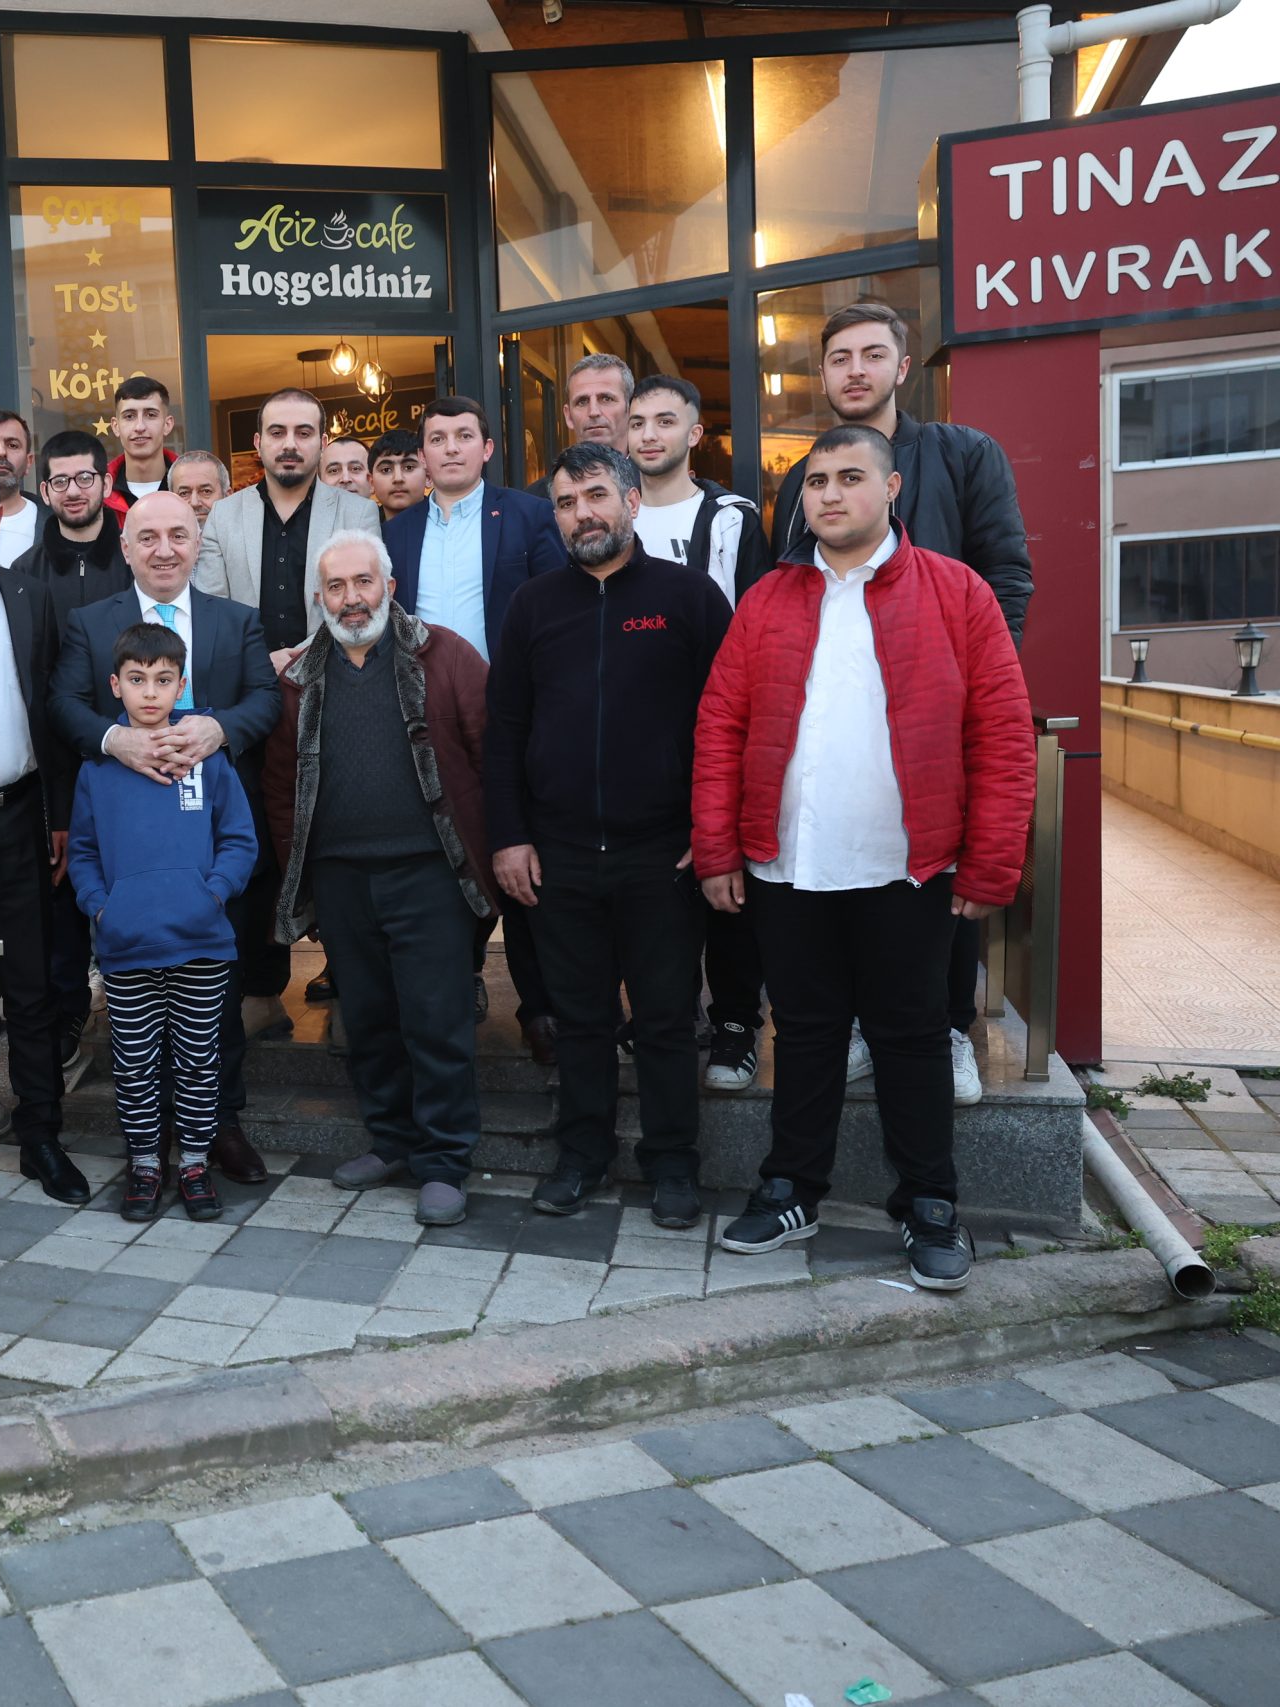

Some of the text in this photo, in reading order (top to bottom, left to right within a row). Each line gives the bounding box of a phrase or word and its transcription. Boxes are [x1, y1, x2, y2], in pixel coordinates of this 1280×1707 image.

[989, 125, 1279, 221] TINAZ
[234, 203, 416, 254] Aziz cafe
[220, 263, 432, 306] Hoşgeldiniz
[975, 228, 1272, 311] KIVRAK
[55, 280, 137, 313] Tost
[49, 363, 147, 401] Köft
[353, 394, 400, 433] cafe
